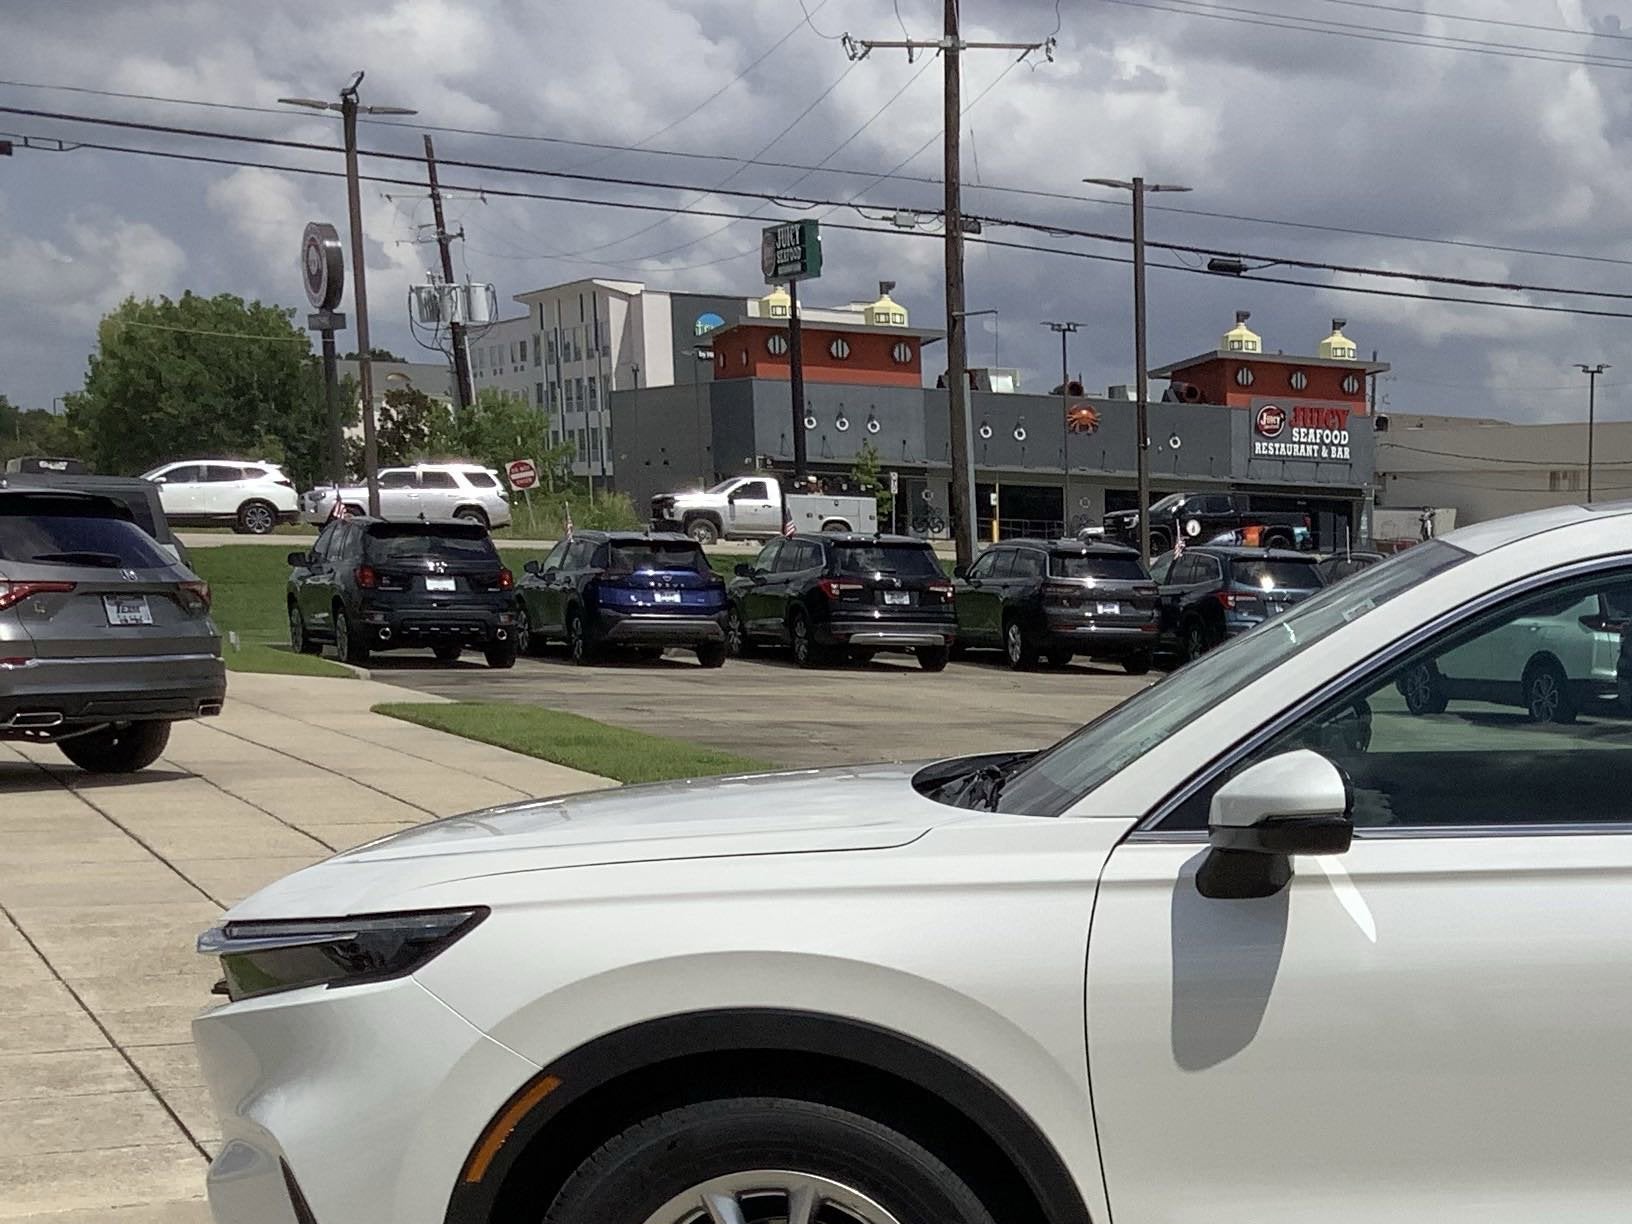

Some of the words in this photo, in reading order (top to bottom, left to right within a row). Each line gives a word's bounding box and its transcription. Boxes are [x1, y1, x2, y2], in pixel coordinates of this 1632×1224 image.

[776, 223, 801, 249] JUICY
[1290, 405, 1350, 428] JUICY
[1292, 427, 1349, 445] SEAFOOD
[1255, 442, 1319, 456] RESTAURANT
[1321, 446, 1329, 458] &
[1331, 446, 1350, 459] BAR
